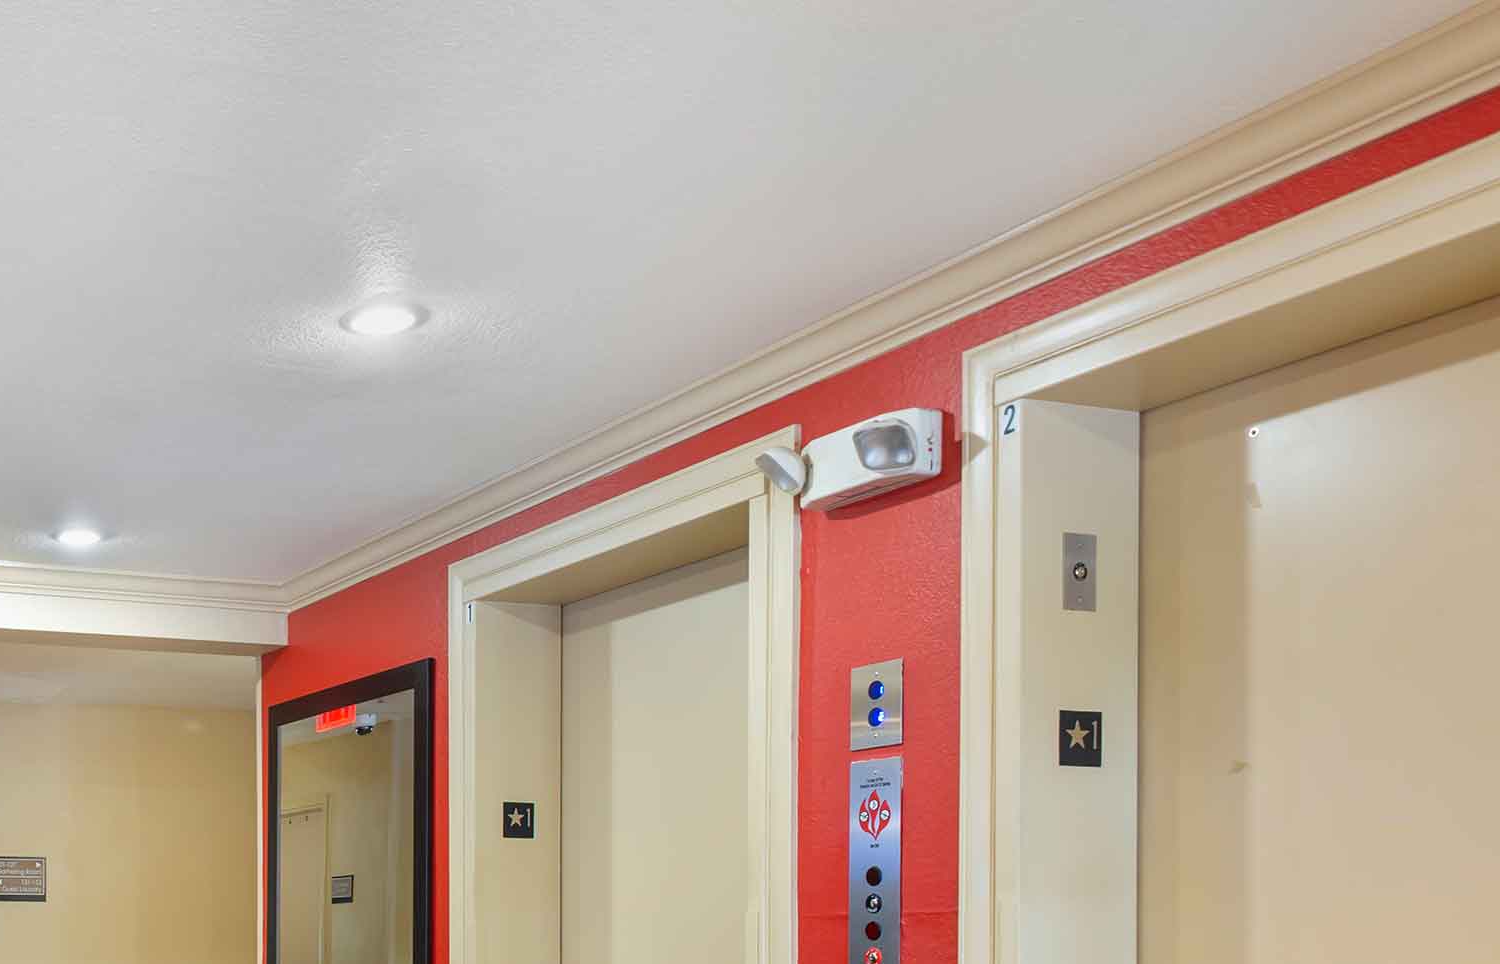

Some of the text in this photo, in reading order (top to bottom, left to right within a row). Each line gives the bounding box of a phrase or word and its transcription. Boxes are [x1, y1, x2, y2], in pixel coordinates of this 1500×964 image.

[1003, 404, 1016, 435] 2
[1091, 720, 1098, 750] 1
[526, 808, 531, 828] 1
